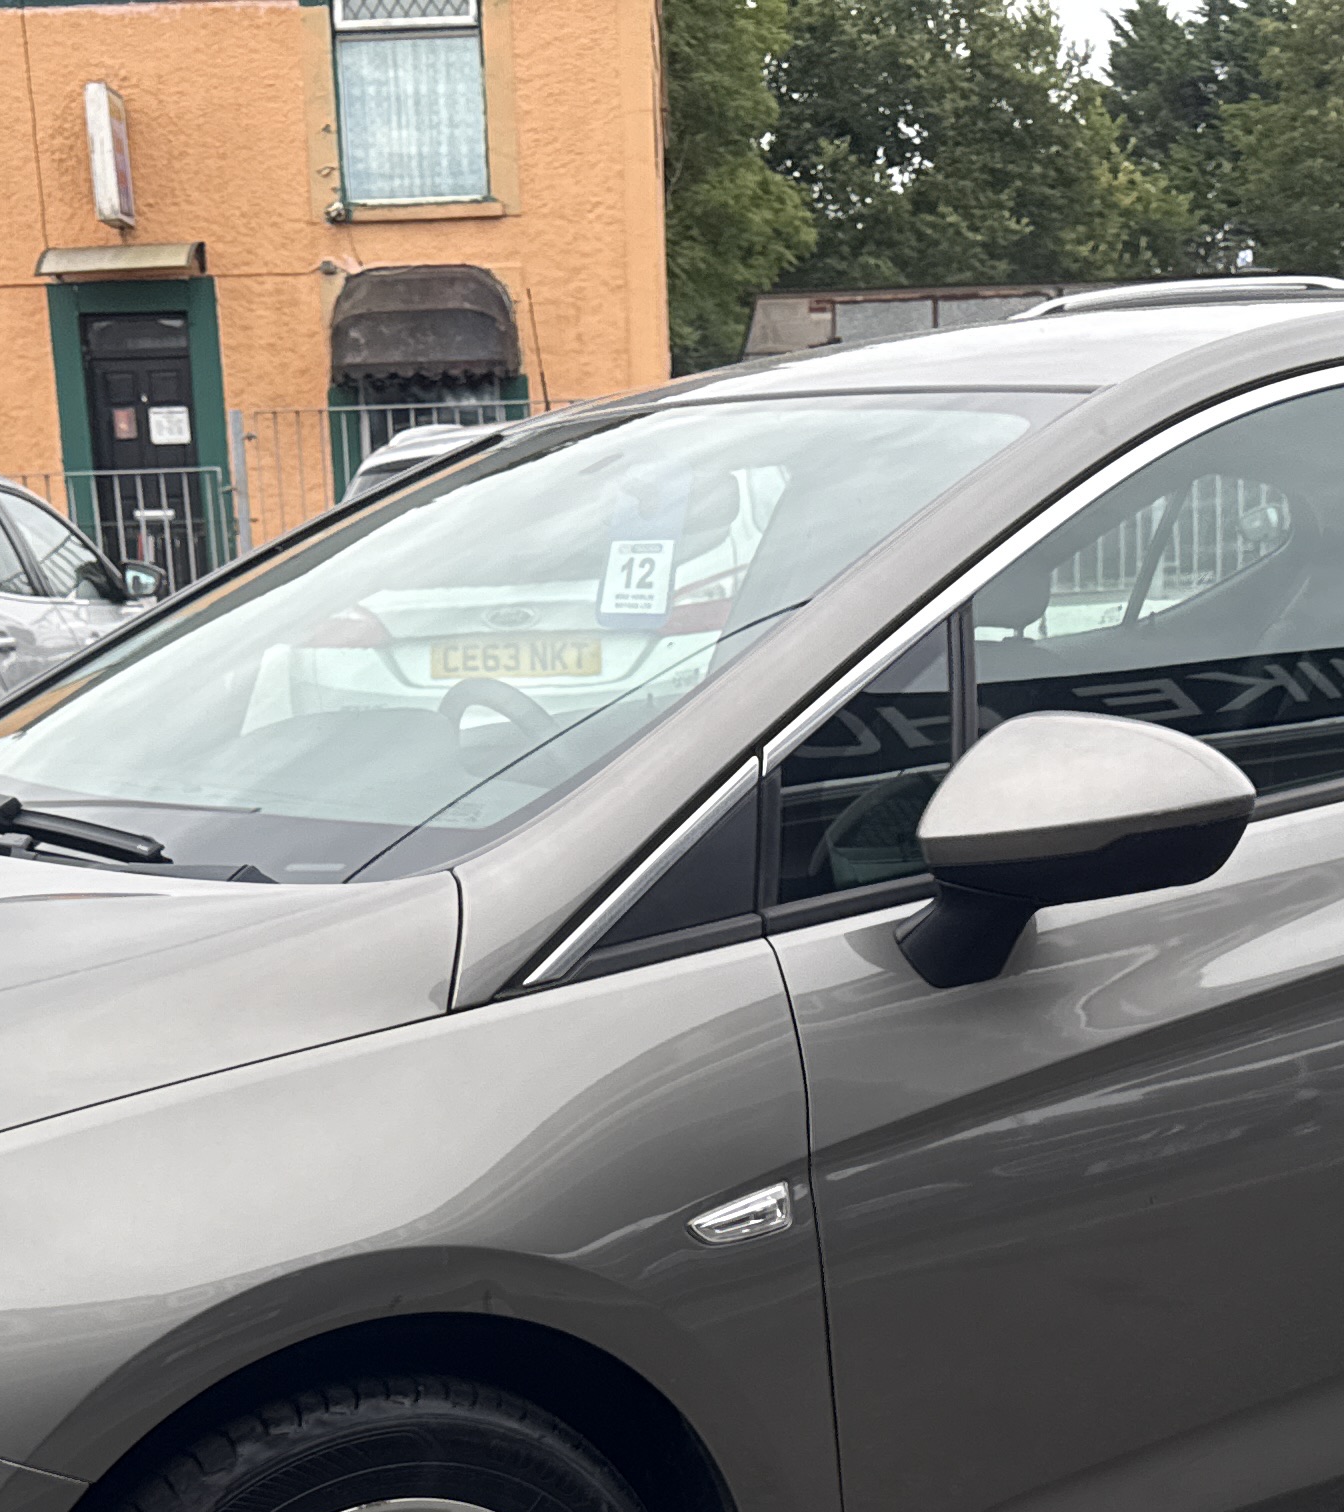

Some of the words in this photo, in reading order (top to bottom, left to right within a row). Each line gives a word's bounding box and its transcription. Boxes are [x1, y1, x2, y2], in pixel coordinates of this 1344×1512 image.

[621, 557, 655, 589] 12
[444, 643, 520, 673] CE63
[530, 641, 589, 671] NKT
